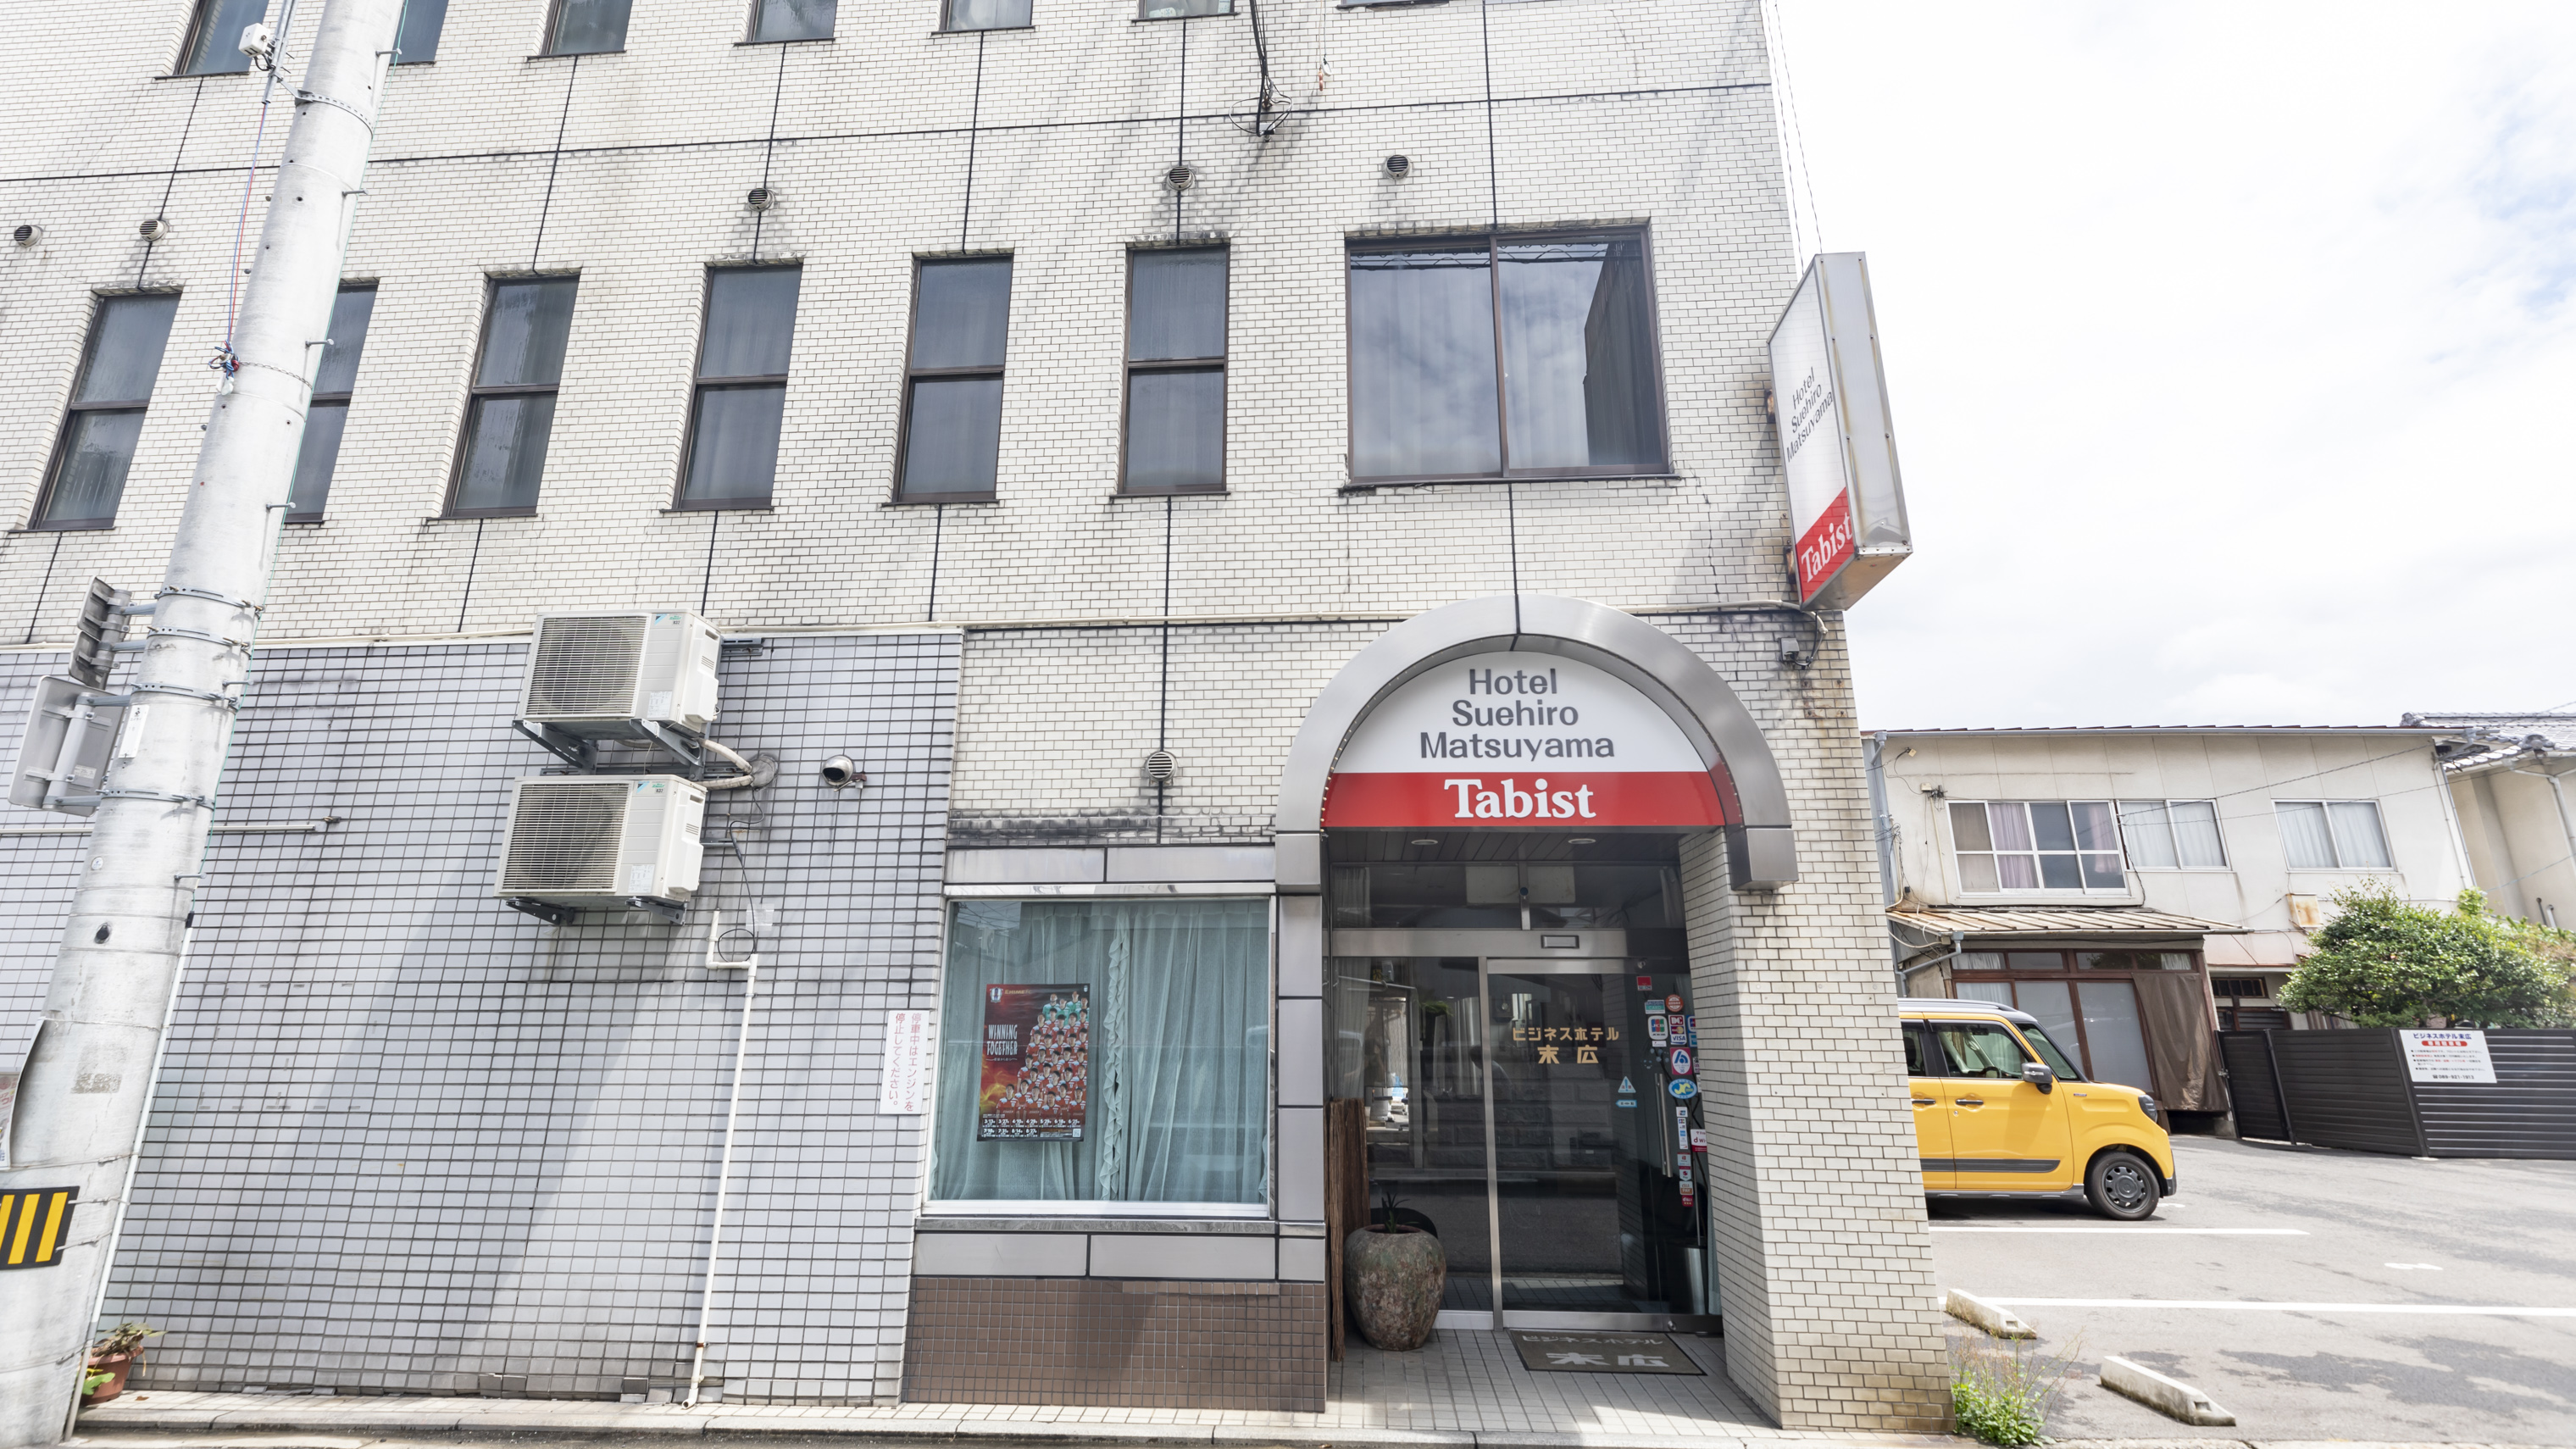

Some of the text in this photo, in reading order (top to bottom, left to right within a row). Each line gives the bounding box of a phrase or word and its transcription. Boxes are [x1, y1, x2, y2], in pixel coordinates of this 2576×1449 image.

[1792, 366, 1815, 410] Hotel
[1790, 383, 1822, 434] Suehiro
[1786, 391, 1833, 463] Matsuyama
[1801, 511, 1853, 584] Tabist
[1468, 668, 1557, 695] Hotel
[1452, 699, 1579, 727] Suehiro
[1419, 731, 1615, 763] Matsuyama
[1443, 778, 1597, 820] Tabist
[988, 1024, 1018, 1040] WINNING
[1512, 1027, 1619, 1041] ビジネスホテル
[888, 1013, 906, 1106] 停止してください。
[904, 1013, 922, 1112] 停車中はエンジンを
[986, 1041, 1018, 1056] TOGETHER
[1537, 1045, 1599, 1064] 末広
[1522, 1335, 1663, 1346] ビジネスホテル
